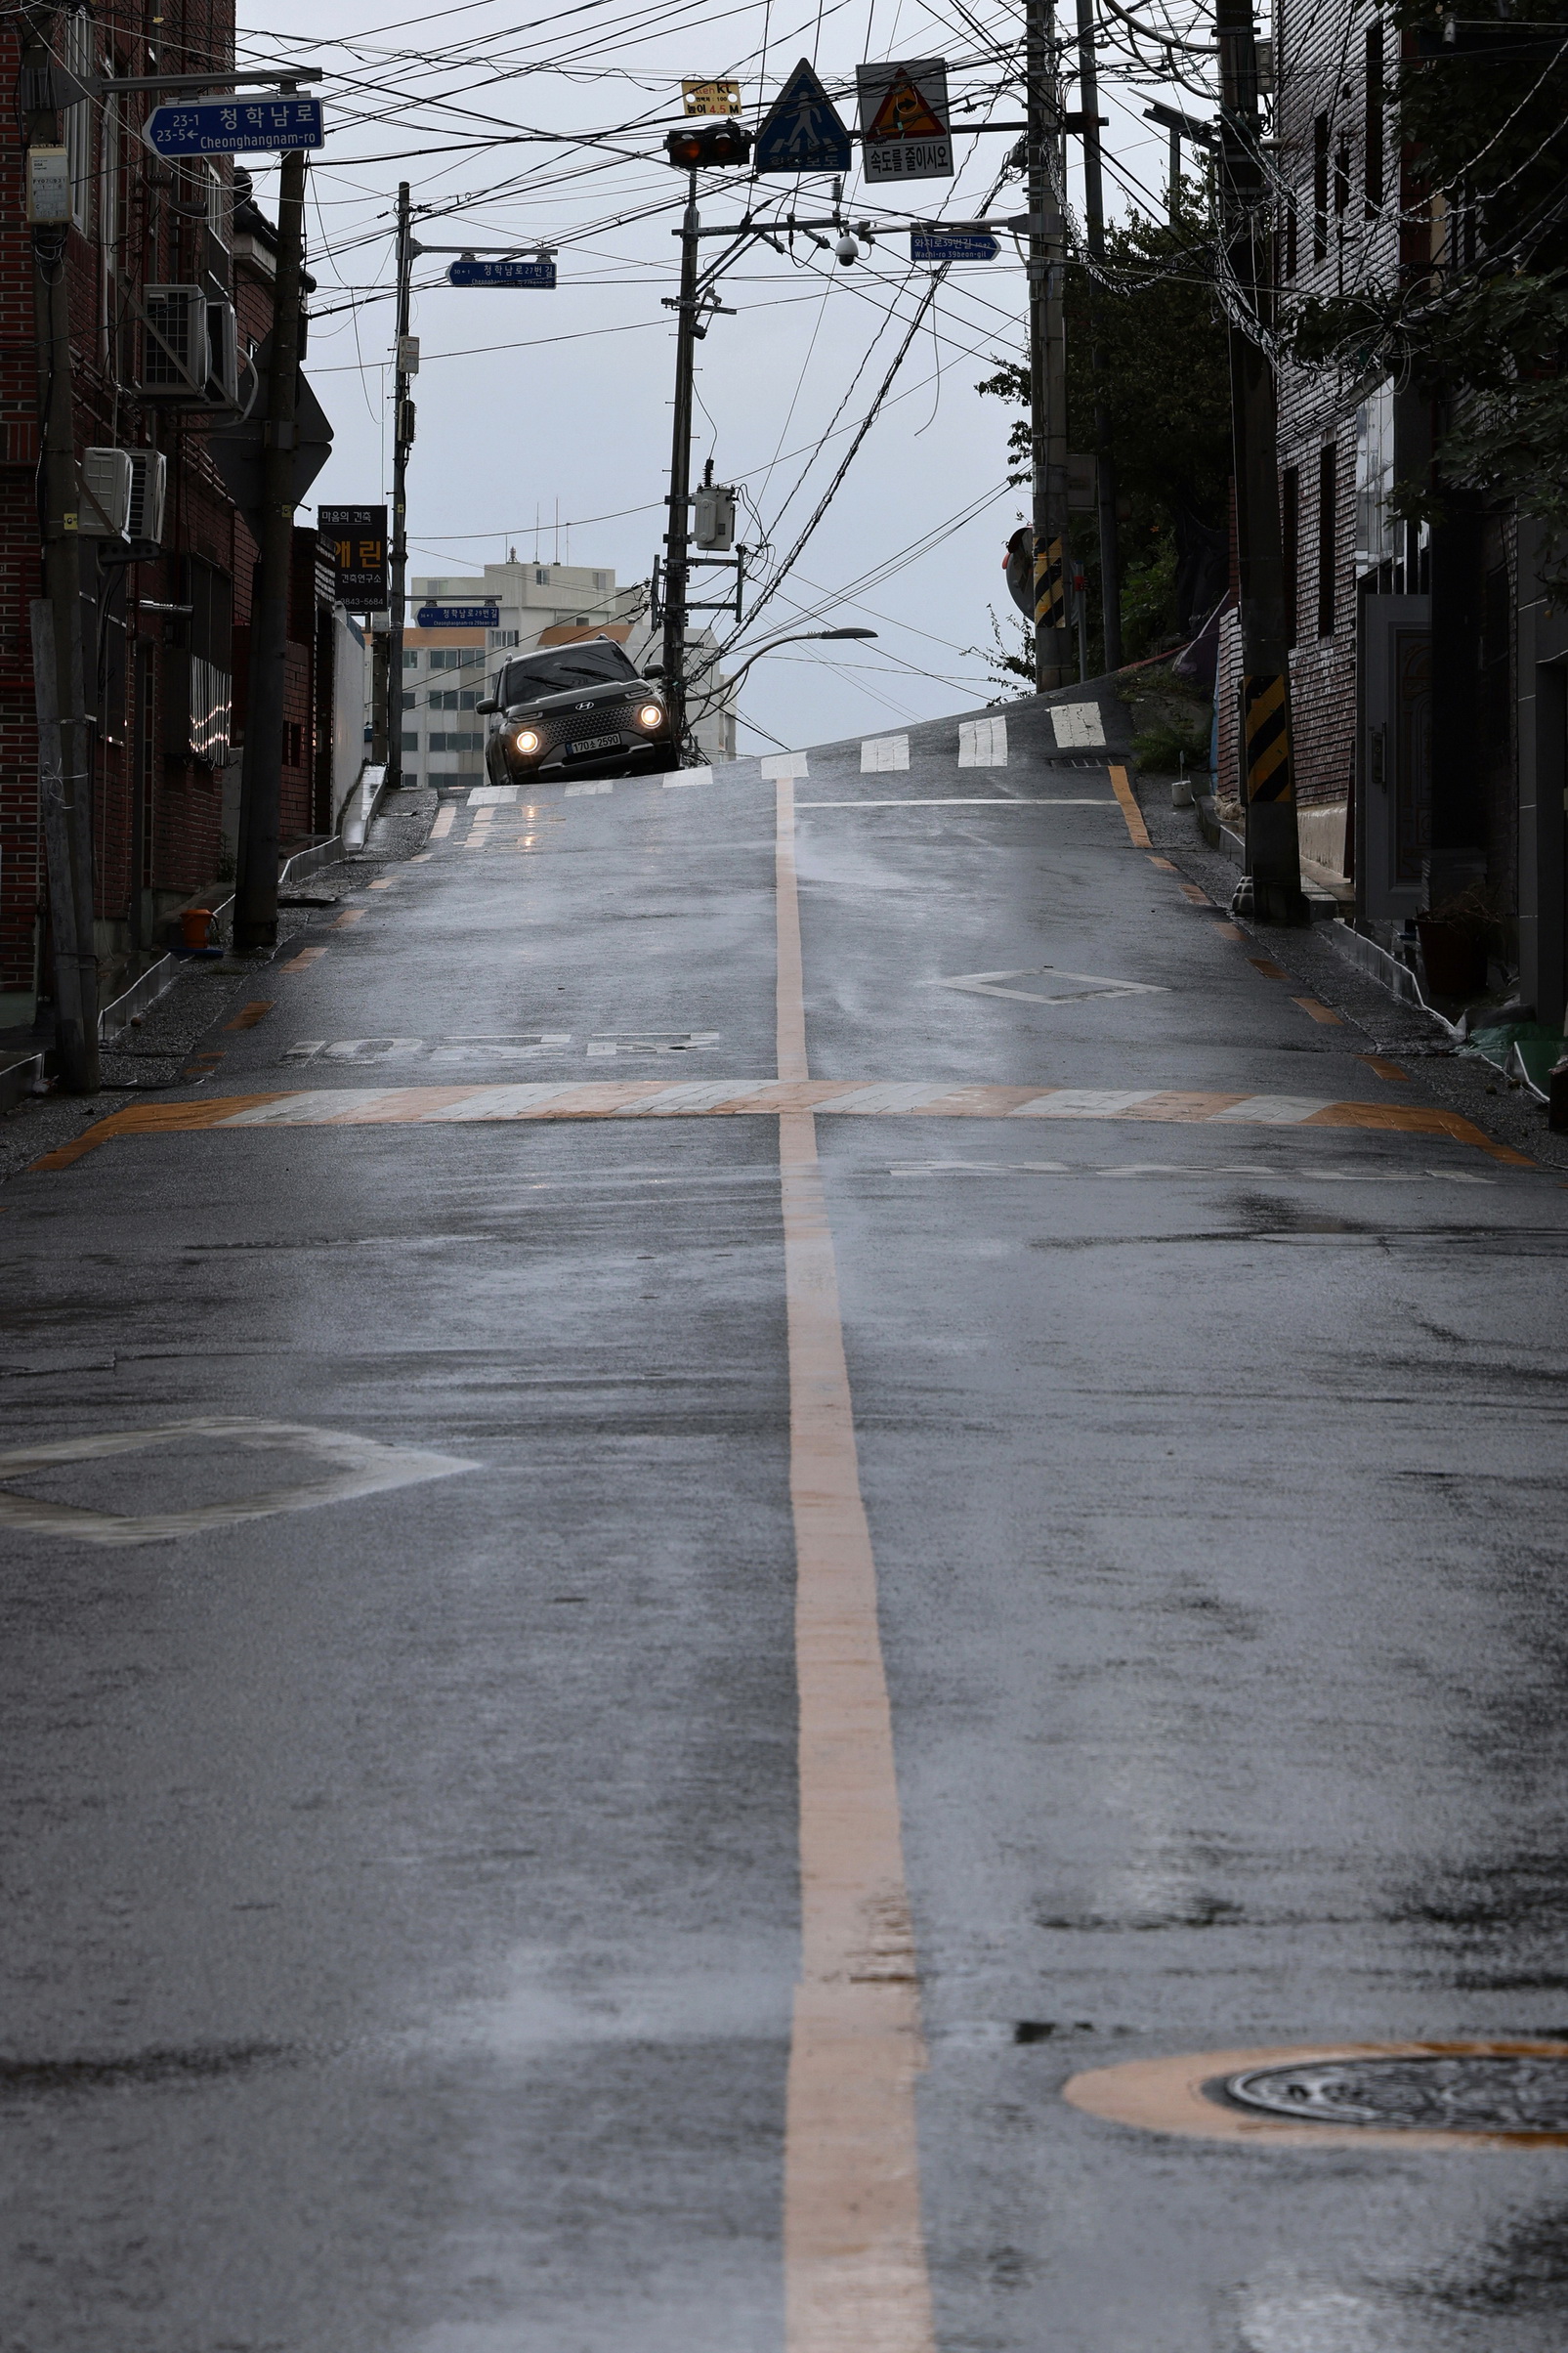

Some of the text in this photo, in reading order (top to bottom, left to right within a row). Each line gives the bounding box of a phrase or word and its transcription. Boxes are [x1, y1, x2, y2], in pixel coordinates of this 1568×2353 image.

[716, 82, 733, 94] kt
[687, 104, 740, 114] 높이 4.5 M
[172, 113, 199, 128] 23-1
[220, 104, 315, 131] 청학남로
[156, 129, 186, 143] 23-5
[199, 132, 317, 150] Cheonghangnam-ro
[870, 145, 949, 174] 속도를 줄이시오
[914, 237, 972, 250] 와치로39번길
[914, 250, 987, 259] Wachi-ro 39beon-gil
[484, 264, 553, 278] 청학남로27번길
[321, 511, 371, 523] 마음의 건축
[341, 574, 382, 583] 건축연구소
[443, 609, 498, 620] 청학남로29번길
[572, 735, 619, 752] 170소 2590
